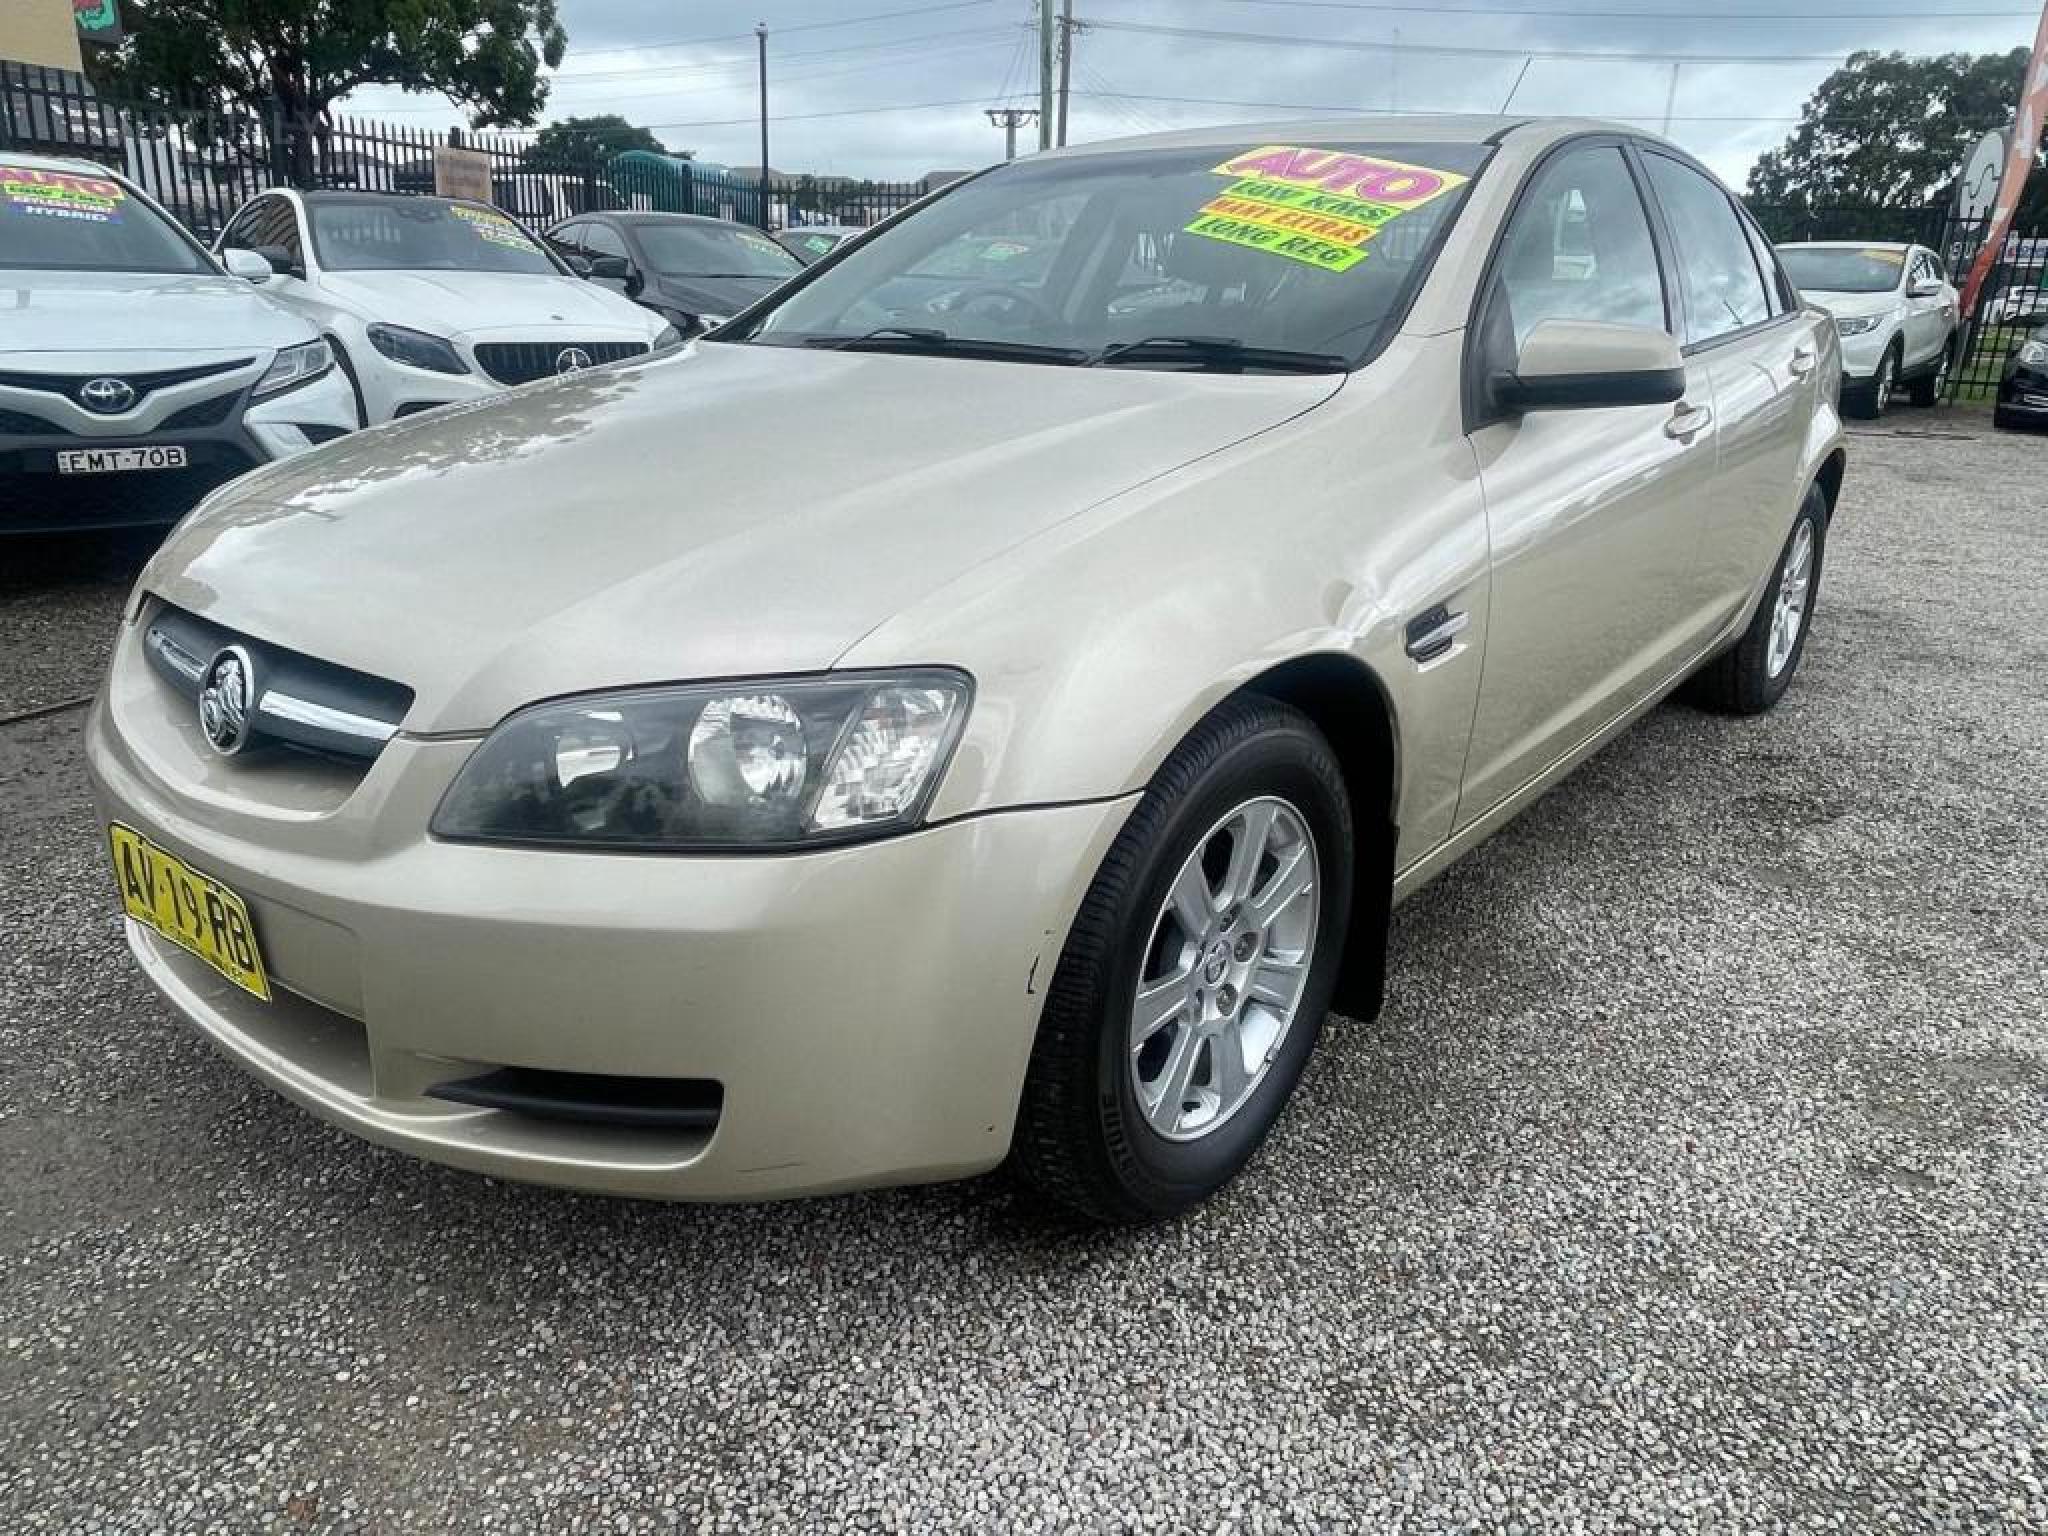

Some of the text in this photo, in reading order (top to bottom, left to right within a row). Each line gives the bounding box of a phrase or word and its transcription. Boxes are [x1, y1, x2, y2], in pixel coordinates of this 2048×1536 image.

[1227, 149, 1443, 203] AUTO
[26, 205, 109, 221] HYBRID
[1212, 199, 1369, 241] MANY EXTRAS
[1231, 180, 1391, 222] LOW KMS
[1199, 218, 1350, 263] LONG REG
